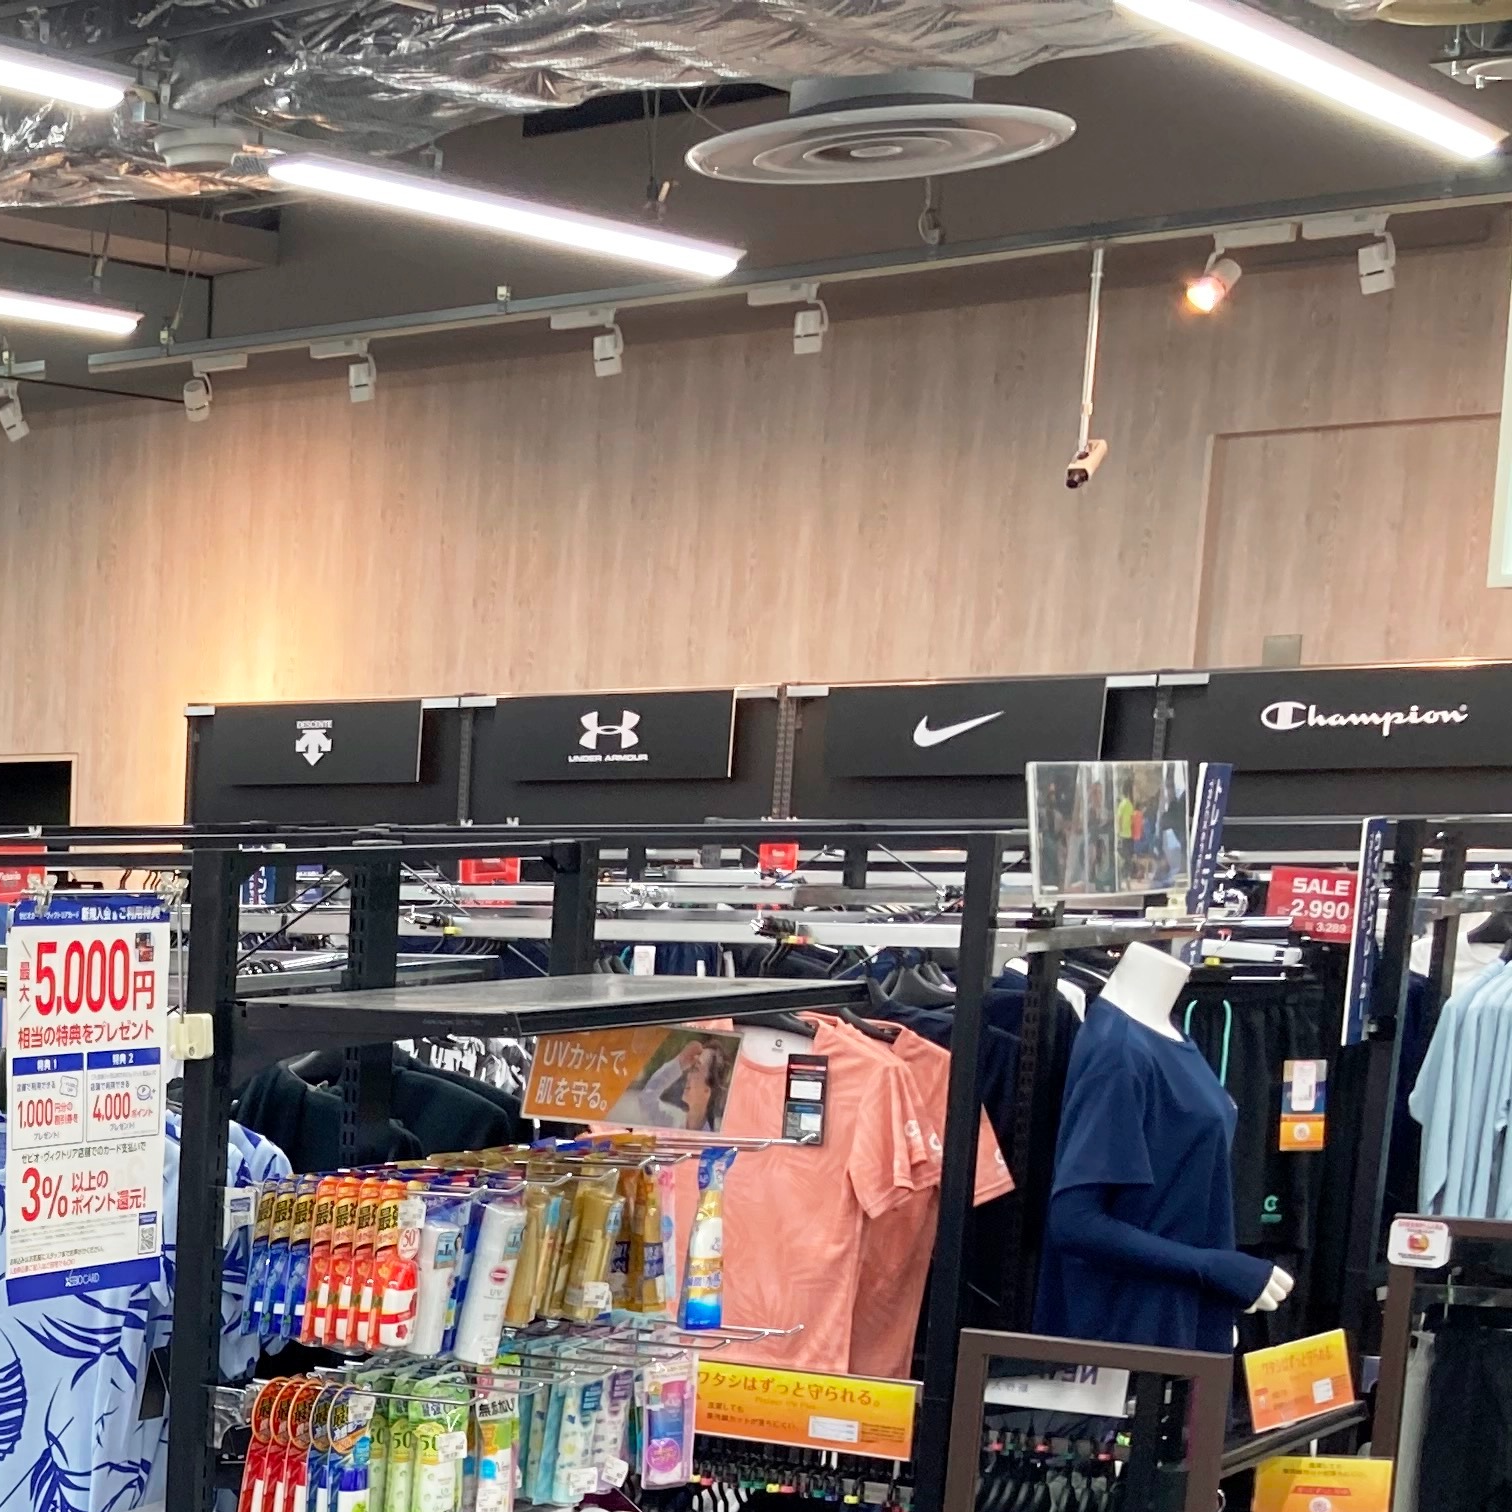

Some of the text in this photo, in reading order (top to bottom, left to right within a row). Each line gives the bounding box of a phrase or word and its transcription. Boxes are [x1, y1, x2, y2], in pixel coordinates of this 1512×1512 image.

[1260, 701, 1468, 736] Champion
[568, 753, 648, 763] UNDER ARMOUR
[1292, 877, 1351, 896] SALE
[1290, 898, 1350, 920] 2,990
[19, 961, 30, 1003] 最大
[18, 1019, 154, 1050] 相当の特典をプレゼント
[543, 1040, 628, 1077] UVカットで、
[535, 1075, 609, 1112] 肌を守る。
[21, 1167, 68, 1222] 3%
[71, 1170, 109, 1193] 以上の
[71, 1187, 147, 1216] ポイント還元!
